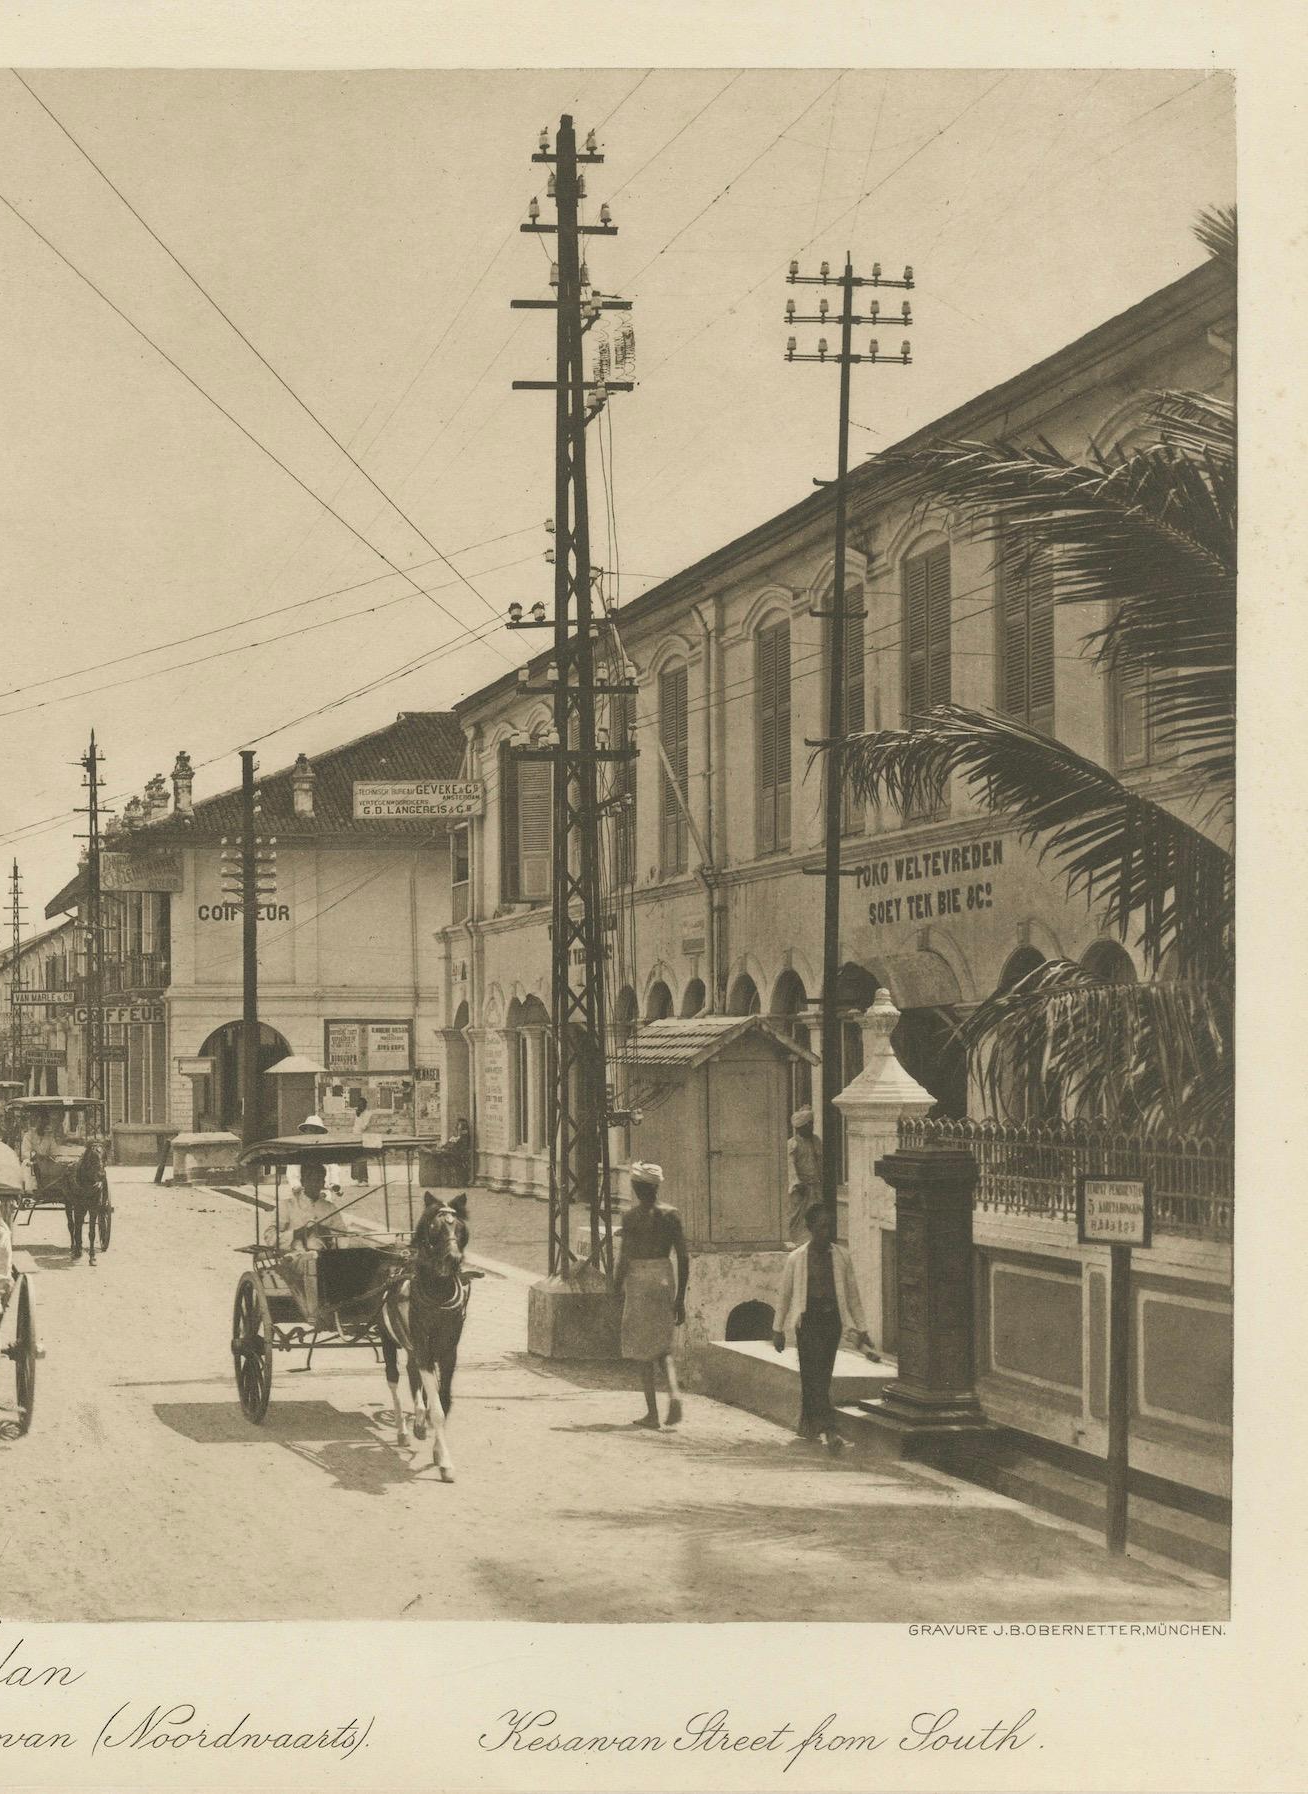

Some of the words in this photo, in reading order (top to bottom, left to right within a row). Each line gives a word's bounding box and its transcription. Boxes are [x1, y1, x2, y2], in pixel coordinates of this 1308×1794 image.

[415, 784, 458, 795] GEVEKE
[857, 861, 889, 889] TOKO
[895, 840, 1003, 882] WELTEVREDEN
[869, 898, 902, 926] SOEY
[906, 893, 933, 920] TEK
[938, 888, 961, 915] BIE
[15, 993, 29, 1002] VAN
